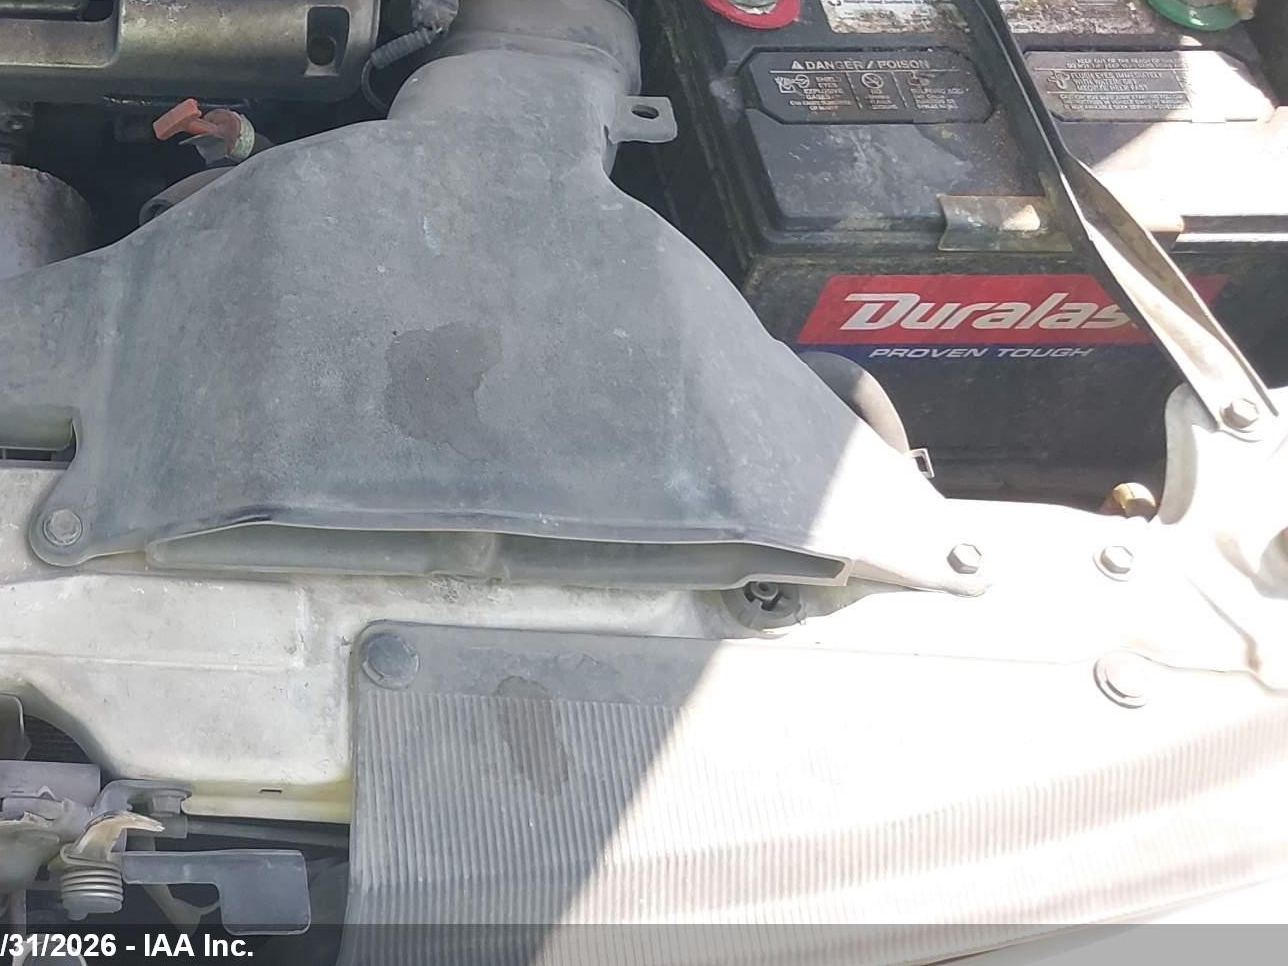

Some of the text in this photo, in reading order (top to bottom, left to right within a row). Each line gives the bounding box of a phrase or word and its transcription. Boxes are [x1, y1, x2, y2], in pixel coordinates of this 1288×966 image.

[805, 60, 863, 70] DANGER
[877, 59, 931, 70] POISON
[840, 292, 1132, 330] Duralas
[869, 347, 1095, 358] PROVEN TOUGH
